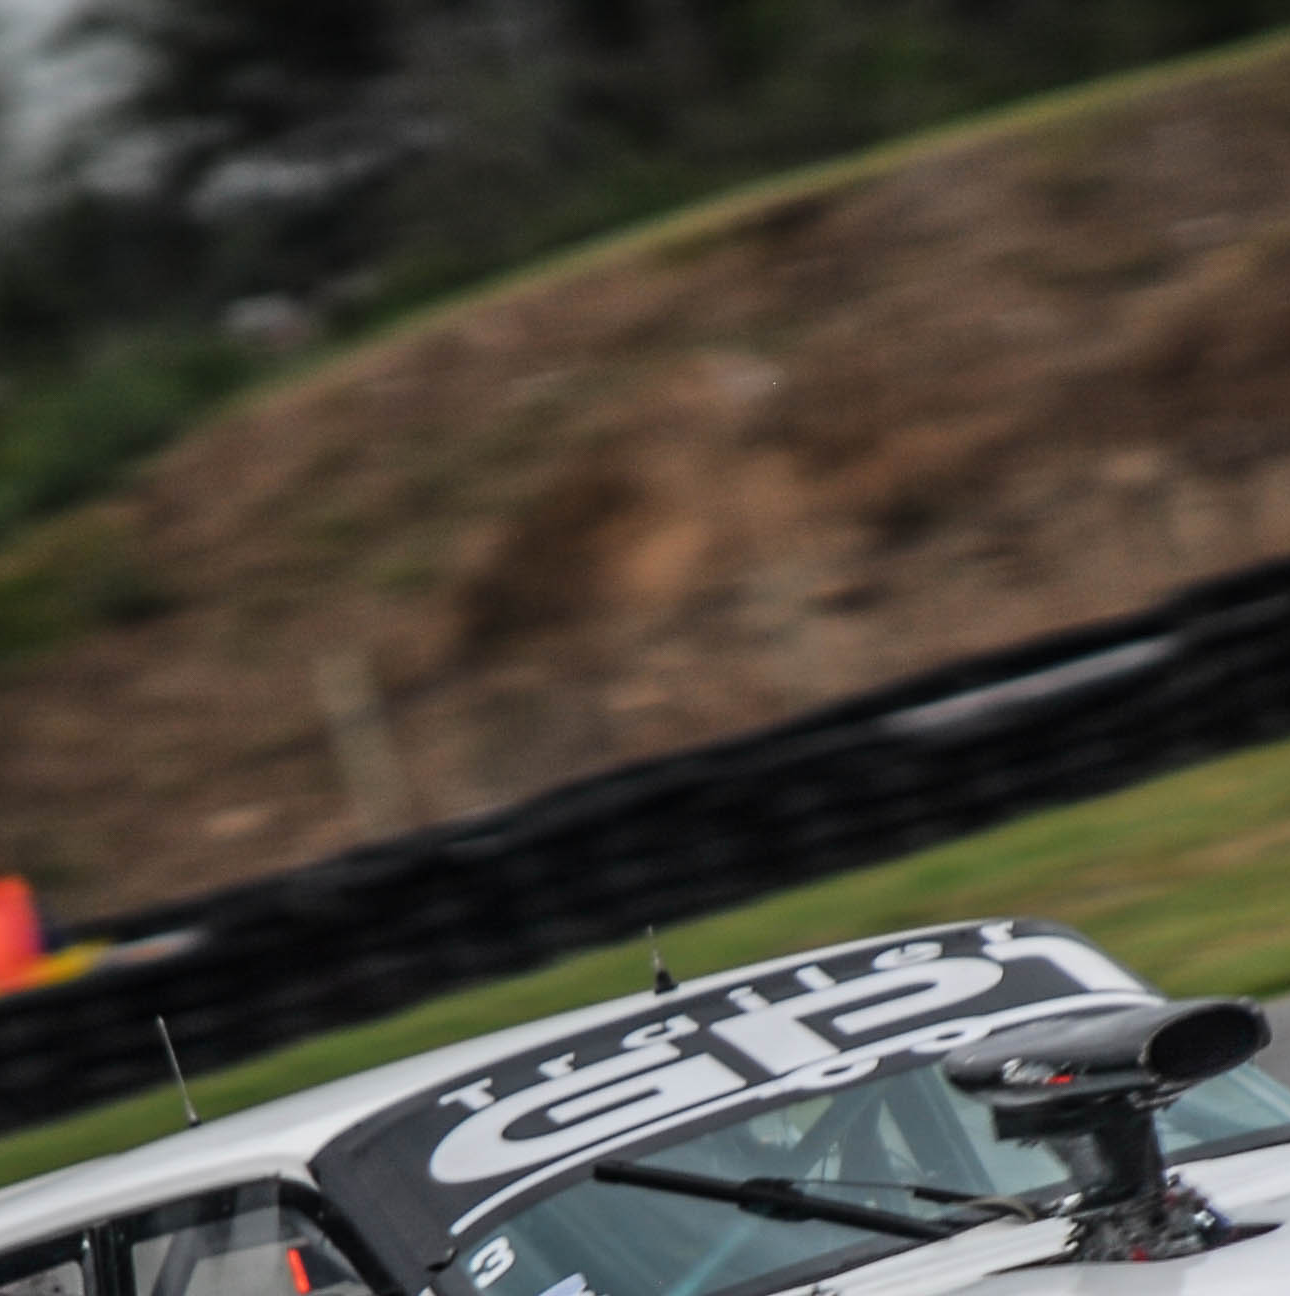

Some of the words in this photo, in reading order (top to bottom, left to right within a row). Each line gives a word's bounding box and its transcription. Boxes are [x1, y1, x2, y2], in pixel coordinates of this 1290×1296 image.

[430, 935, 1159, 1185] GP1
[439, 920, 1015, 1113] Trailer
[469, 1236, 516, 1290] 3
